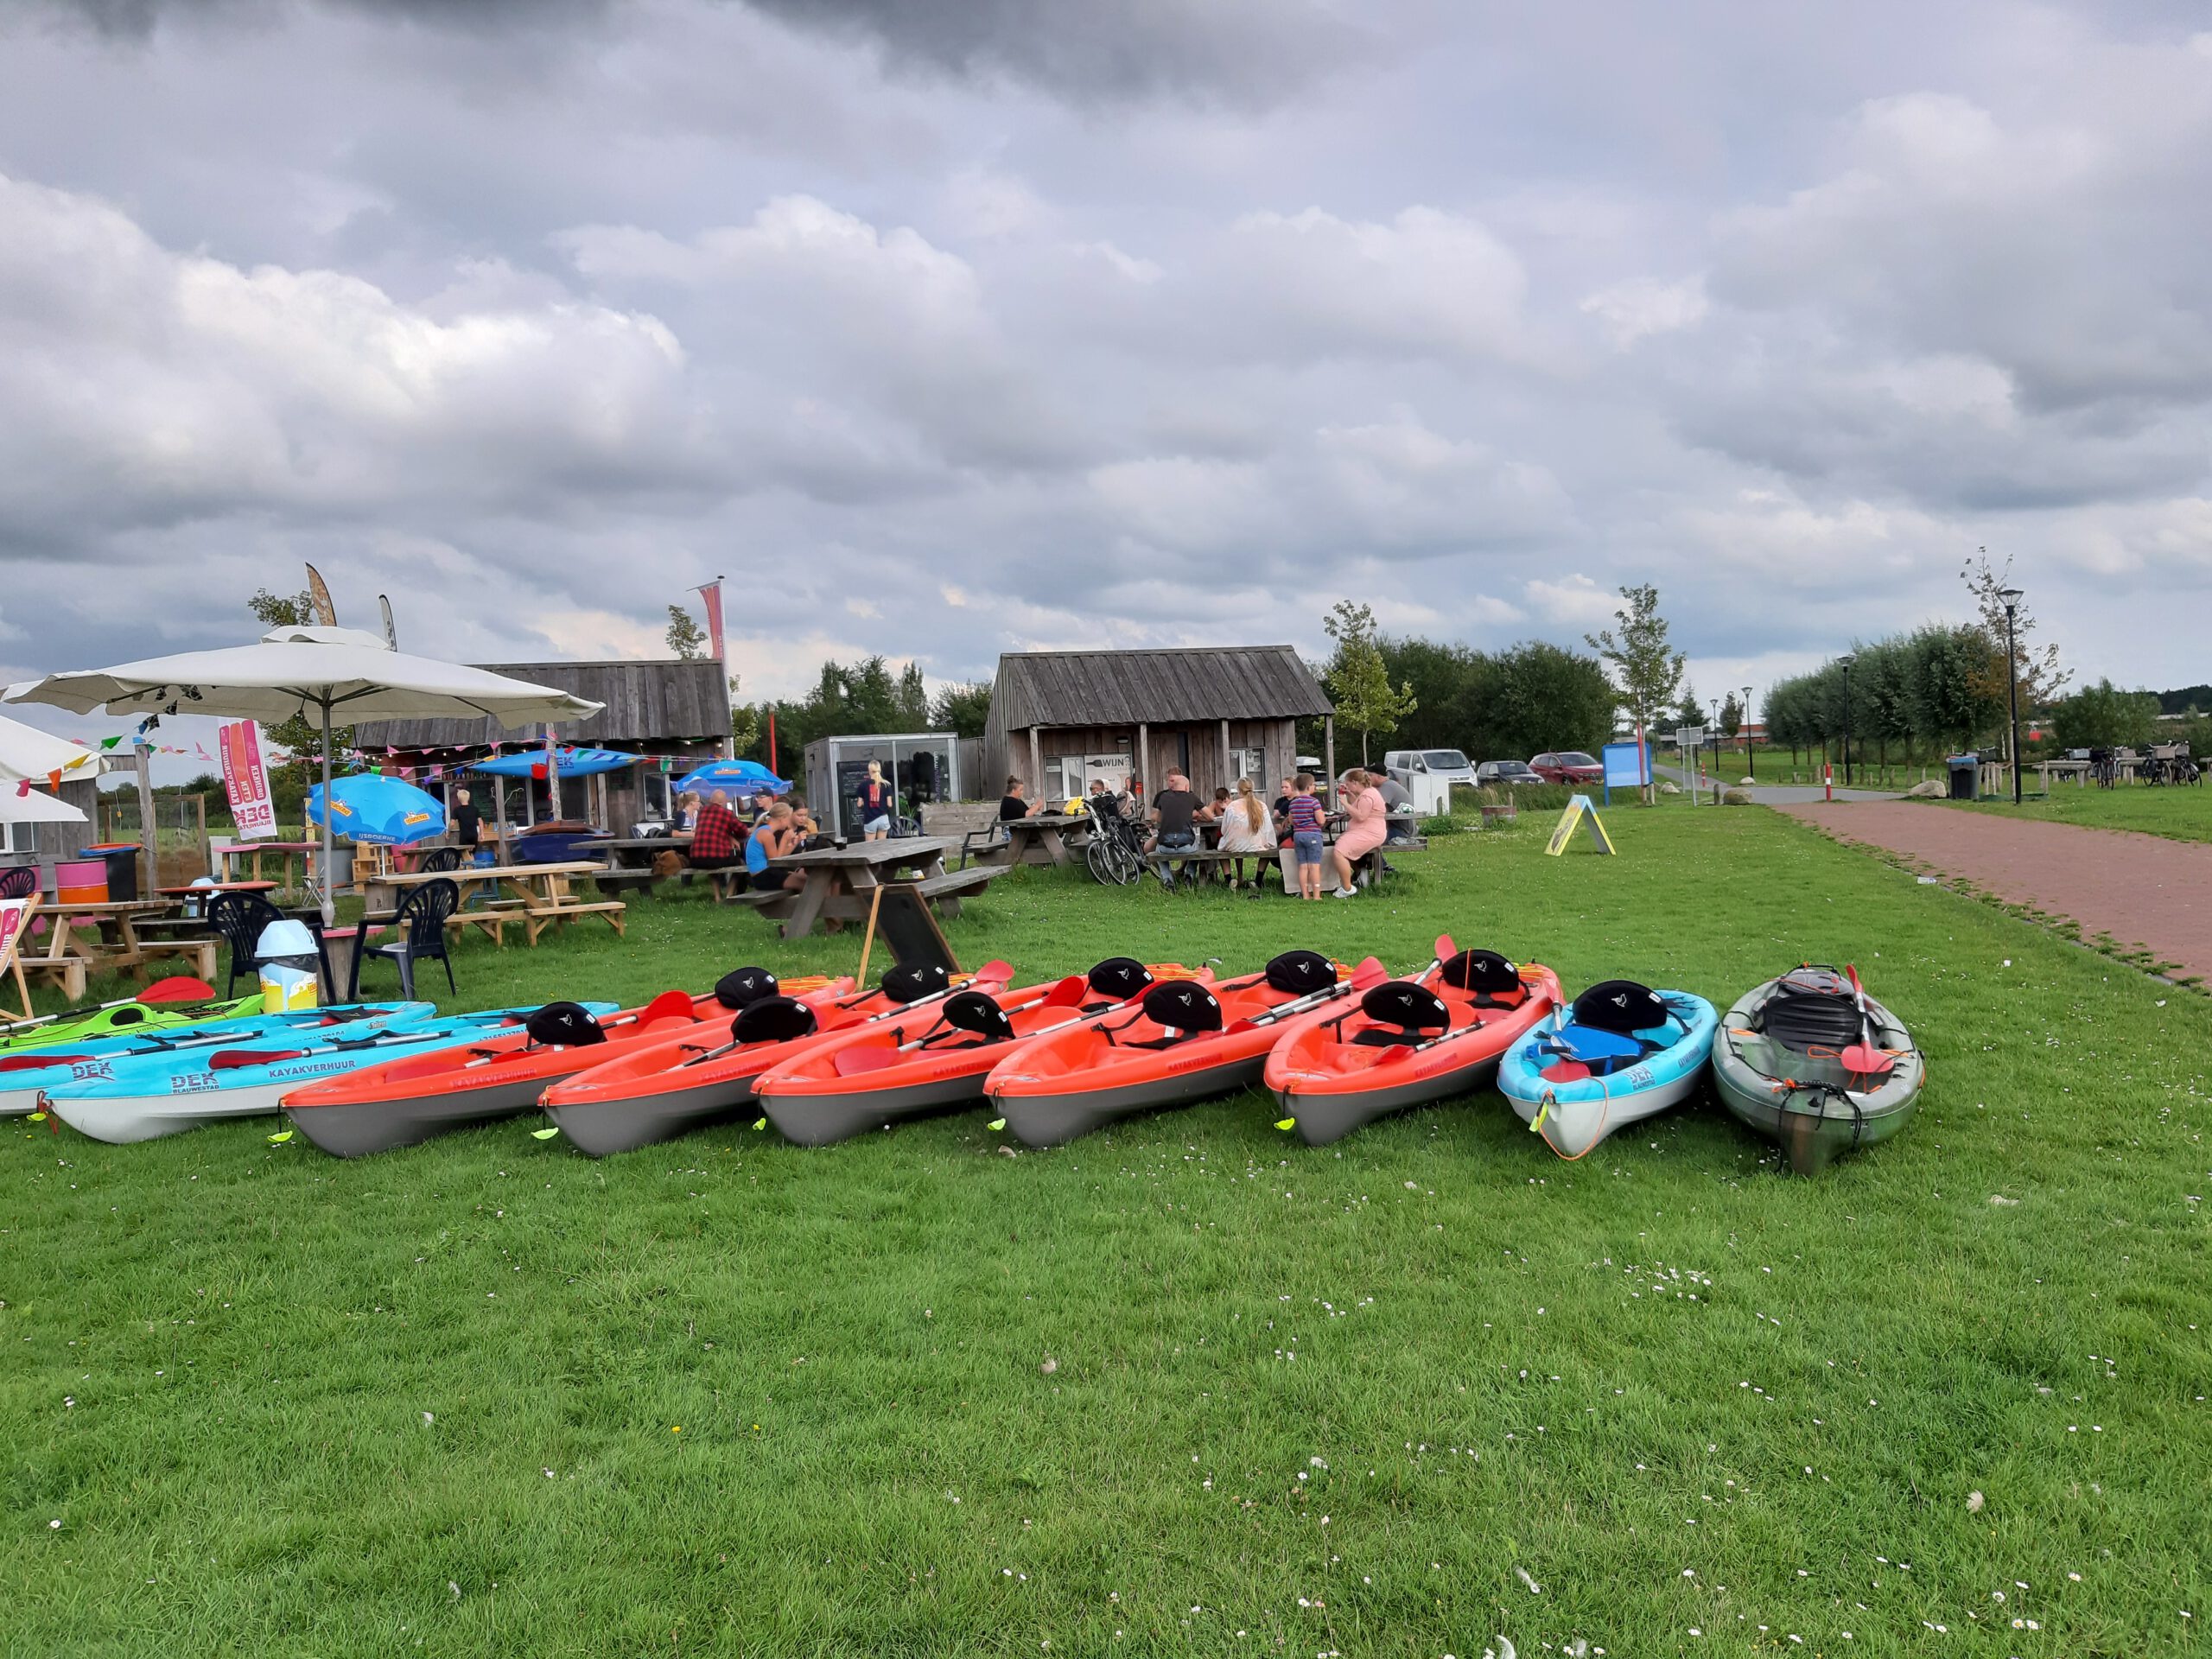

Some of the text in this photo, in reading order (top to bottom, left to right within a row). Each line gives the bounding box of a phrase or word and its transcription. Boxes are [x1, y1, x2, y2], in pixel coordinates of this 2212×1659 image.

[1103, 759, 1124, 767] WIJN
[72, 1062, 114, 1079] DEK
[269, 1060, 355, 1077] KAYAKVERHUUR
[171, 1072, 218, 1088] DEK
[173, 1084, 219, 1094] BLAUWESTAD
